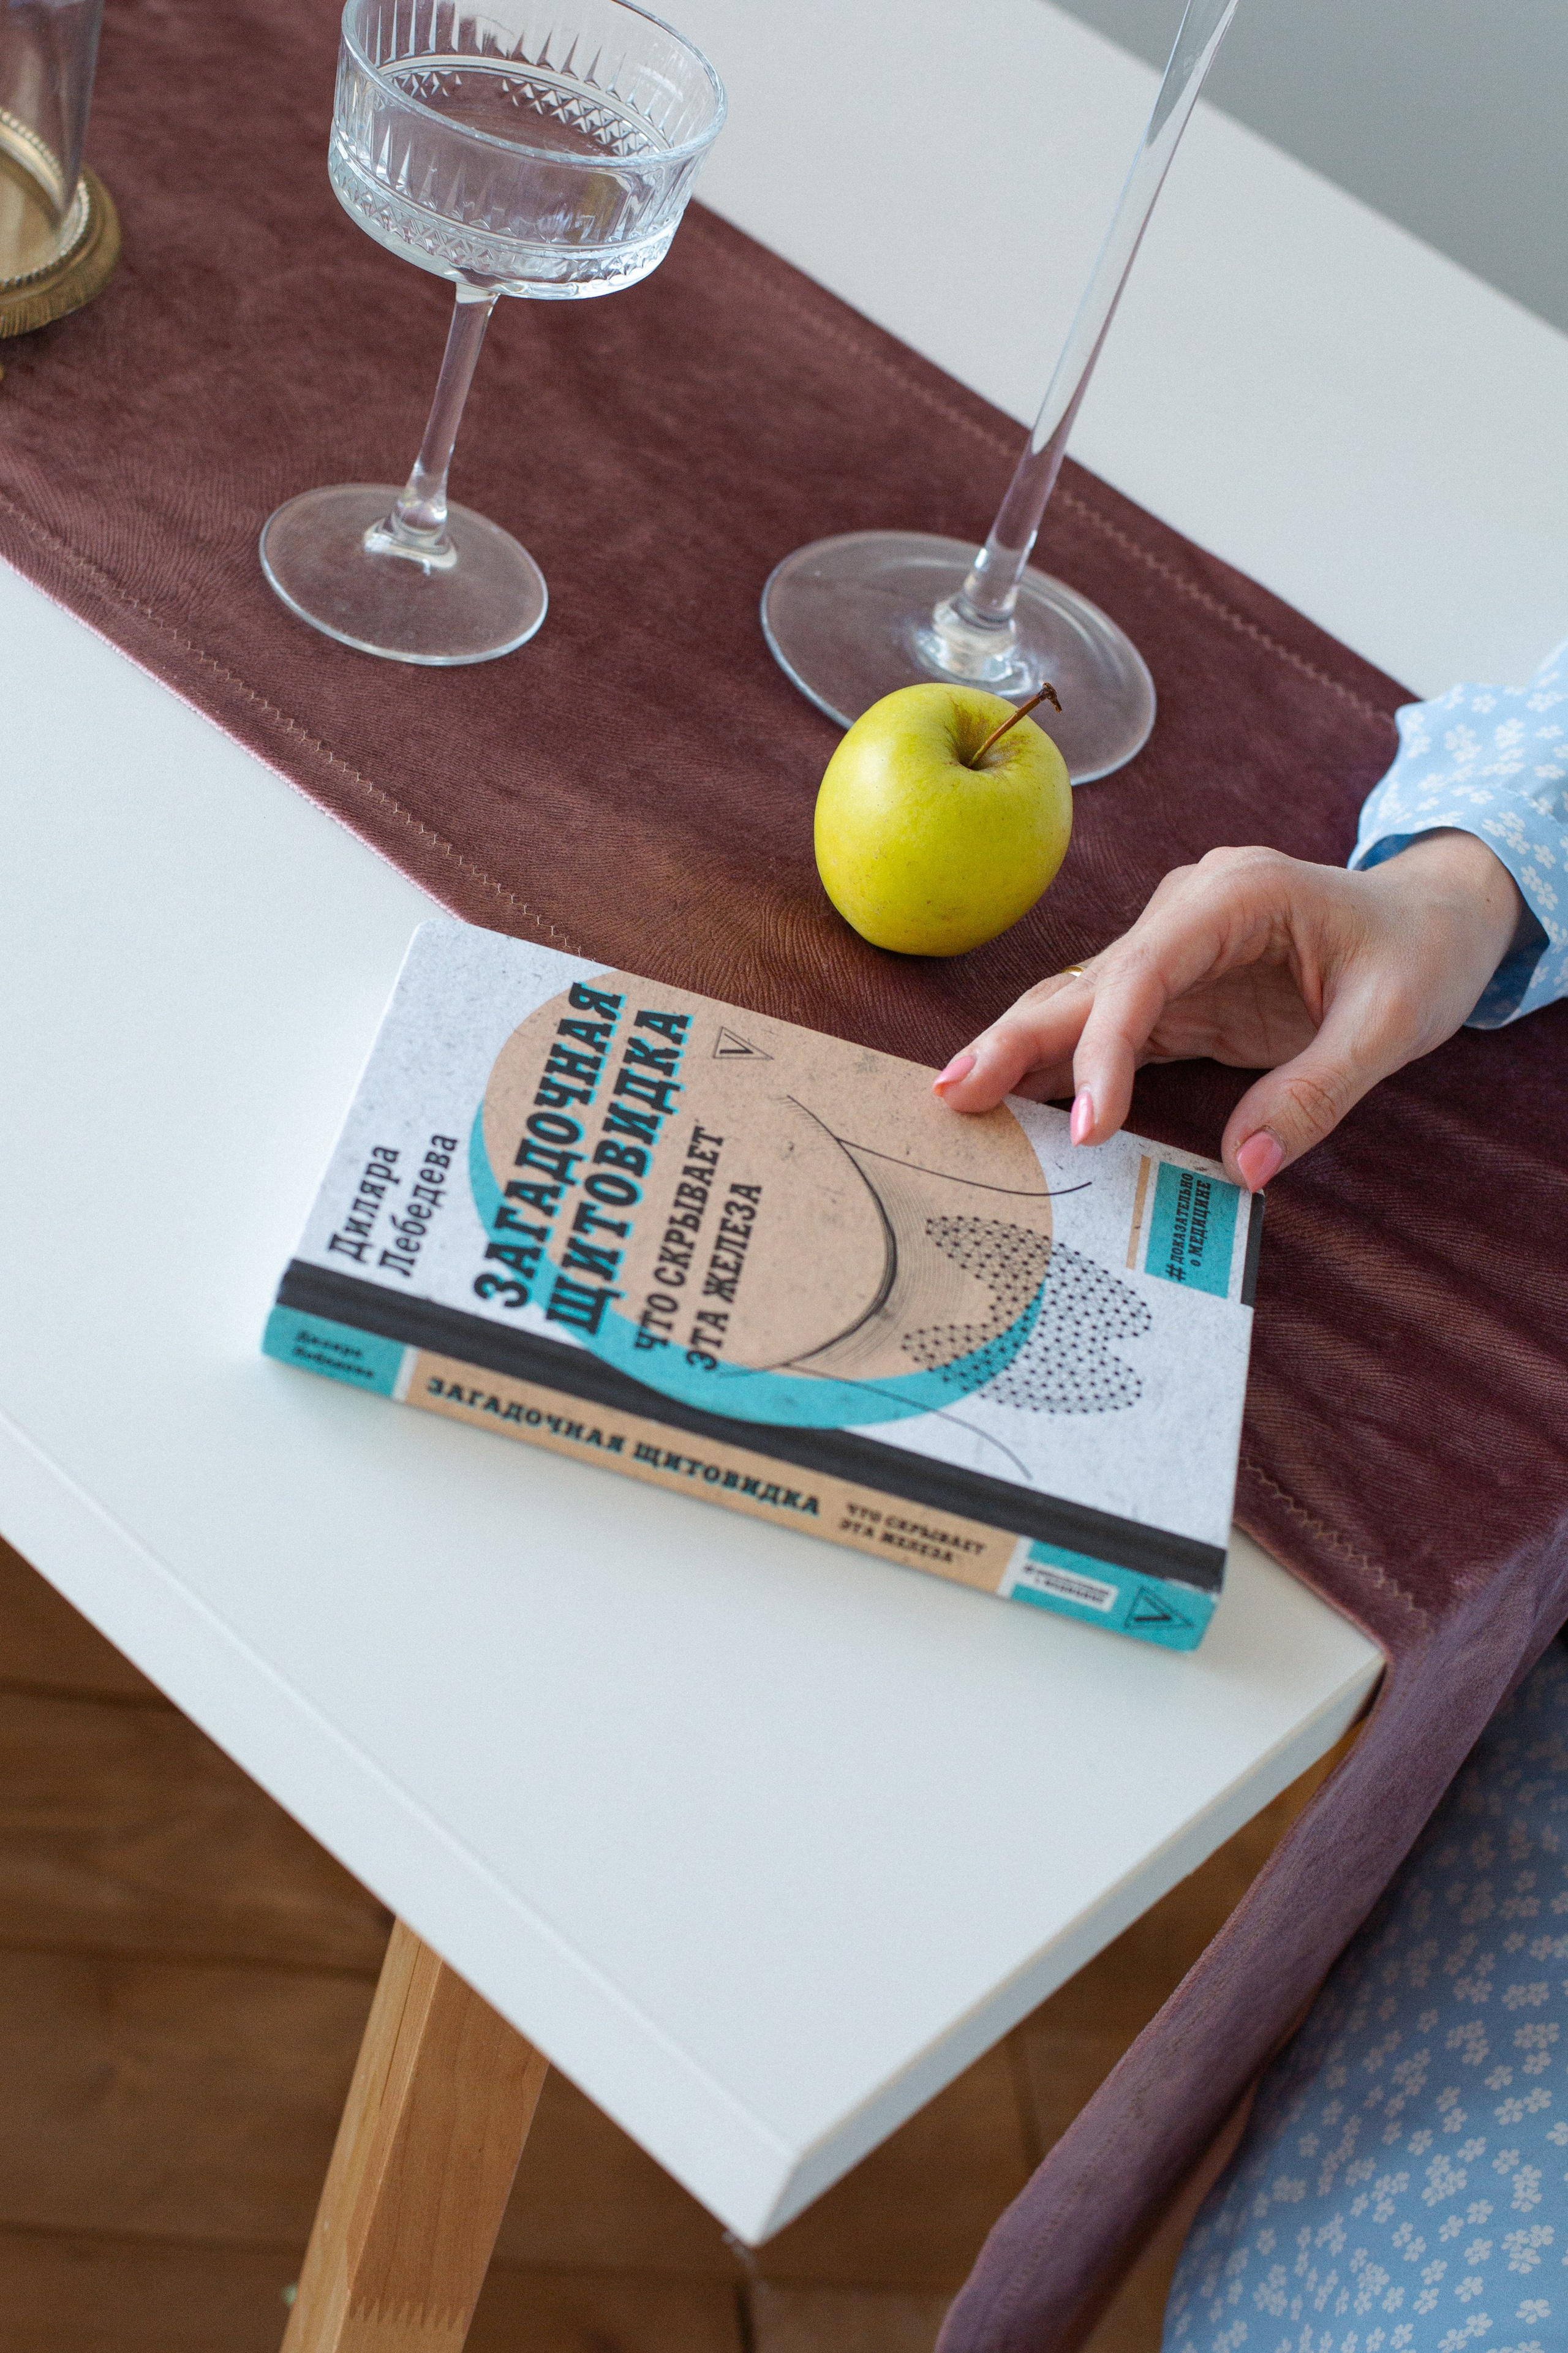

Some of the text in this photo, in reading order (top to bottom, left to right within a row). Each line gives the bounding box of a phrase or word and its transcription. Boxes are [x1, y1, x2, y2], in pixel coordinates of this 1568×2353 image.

[328, 1146, 400, 1264] Диляра
[379, 1135, 458, 1277] Лебедева
[473, 981, 625, 1310] ЗАГАДОЧНАЯ
[546, 1008, 695, 1337] ЩИТОВИДКА
[1188, 1179, 1211, 1257] МЕДИЦИНЕ
[635, 1125, 724, 1352] ЧТО СКРЫВАЕТ
[686, 1182, 763, 1371] ЭТА ЖЕЛЕЗА
[427, 1375, 820, 1517] ЗАГАДОЧНАЯ ЩИТОВИДКА
